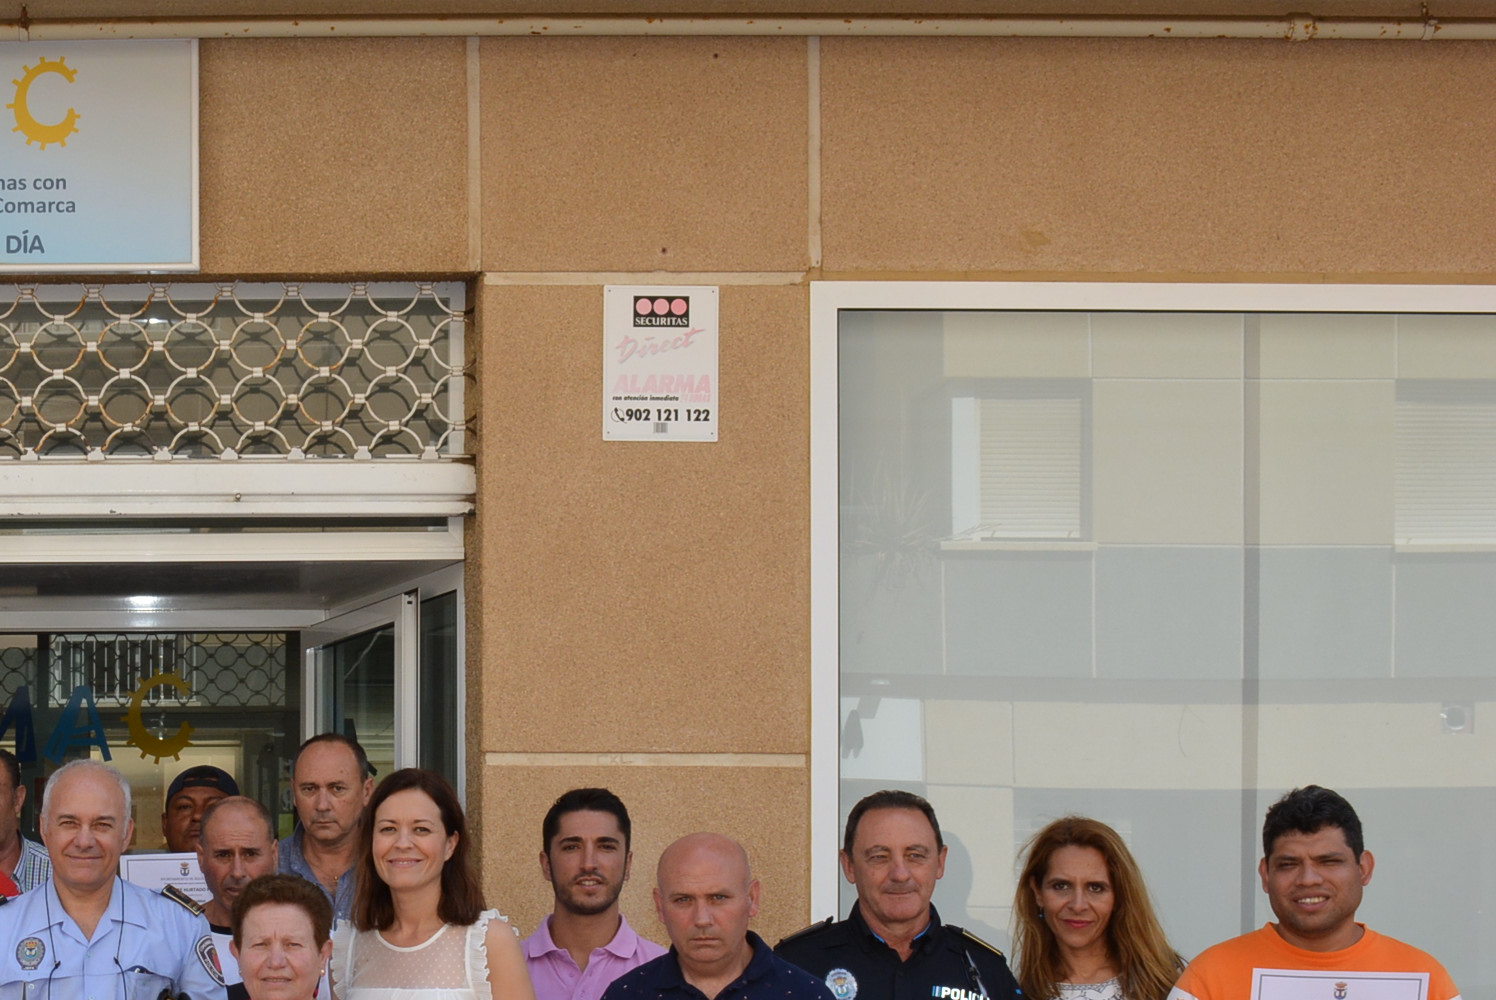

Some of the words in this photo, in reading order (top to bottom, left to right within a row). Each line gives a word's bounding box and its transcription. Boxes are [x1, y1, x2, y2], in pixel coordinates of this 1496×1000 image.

[33, 178, 67, 190] con
[6, 230, 45, 254] DÍA
[635, 317, 687, 326] SECURITAS
[616, 327, 706, 364] Direct
[614, 374, 711, 393] ALARMA
[626, 409, 650, 421] 902
[657, 409, 678, 421] 121
[686, 409, 710, 422] 122
